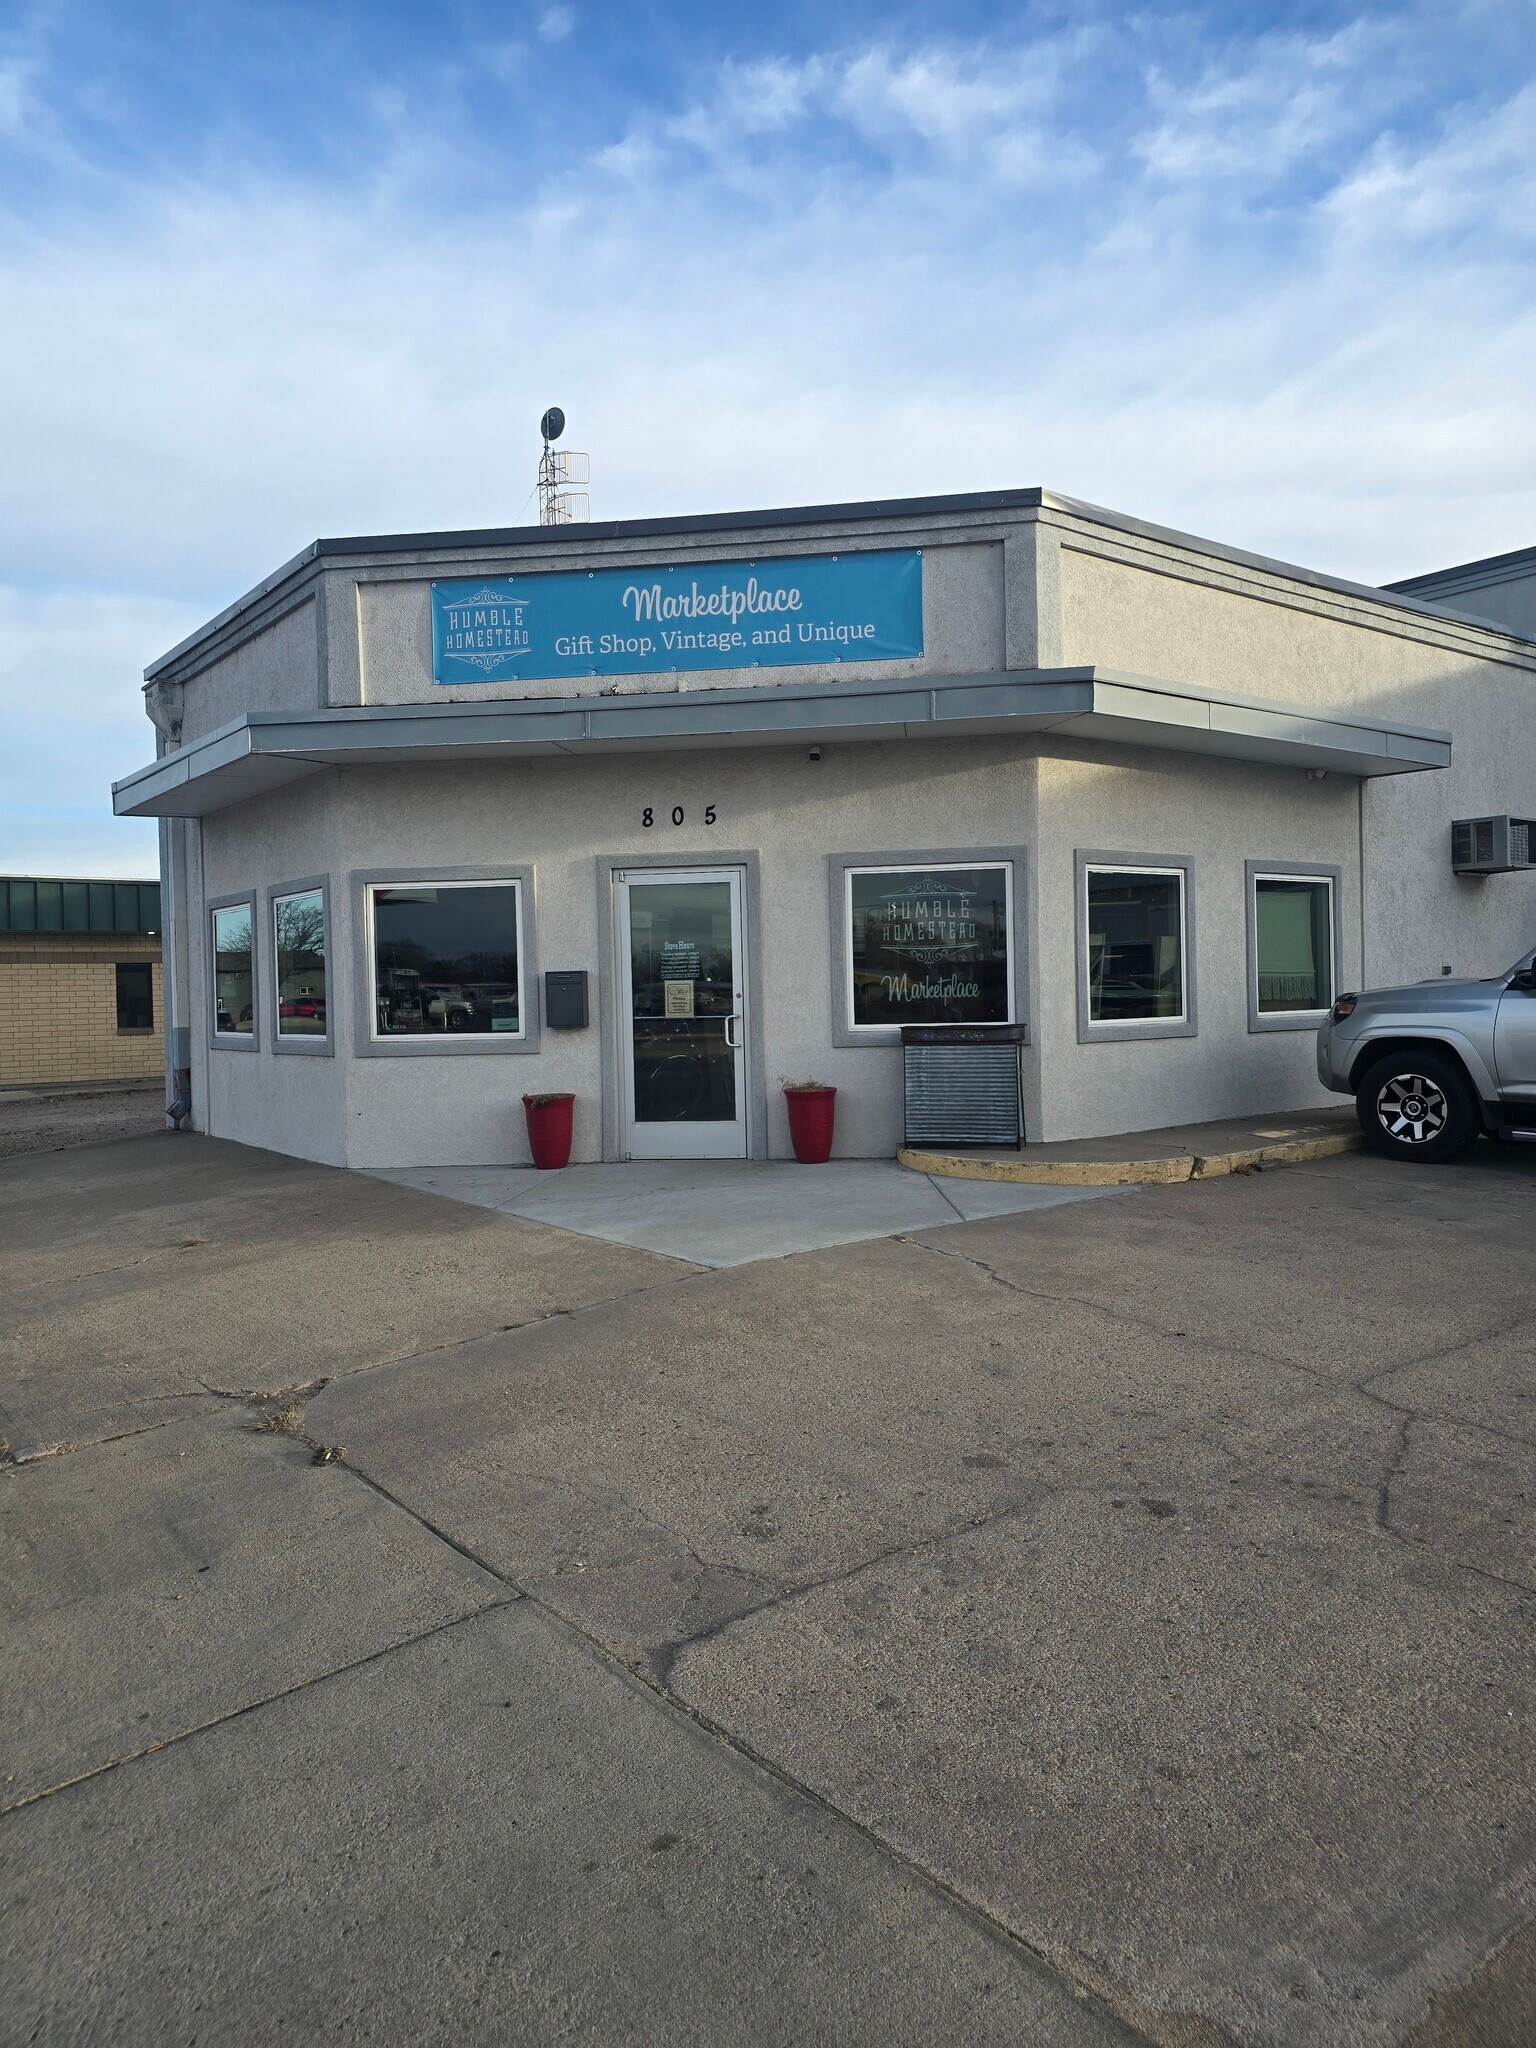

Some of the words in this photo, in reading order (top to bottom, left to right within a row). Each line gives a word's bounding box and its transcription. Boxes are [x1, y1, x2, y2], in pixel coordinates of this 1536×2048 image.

[622, 577, 803, 625] Marketplace
[449, 608, 523, 630] HUMBLE
[446, 629, 529, 649] HOMESTEAD
[555, 635, 594, 656] Gift
[600, 634, 656, 656] Shop,
[661, 630, 747, 652] Vintage,
[752, 624, 791, 645] and
[797, 621, 875, 645] Unique
[642, 804, 717, 828] 805
[887, 899, 970, 921] HUMBLE
[883, 921, 976, 941] HOMESTEAD
[664, 941, 678, 950] Store
[678, 941, 695, 950] Hours
[881, 973, 980, 1006] Marketplace
